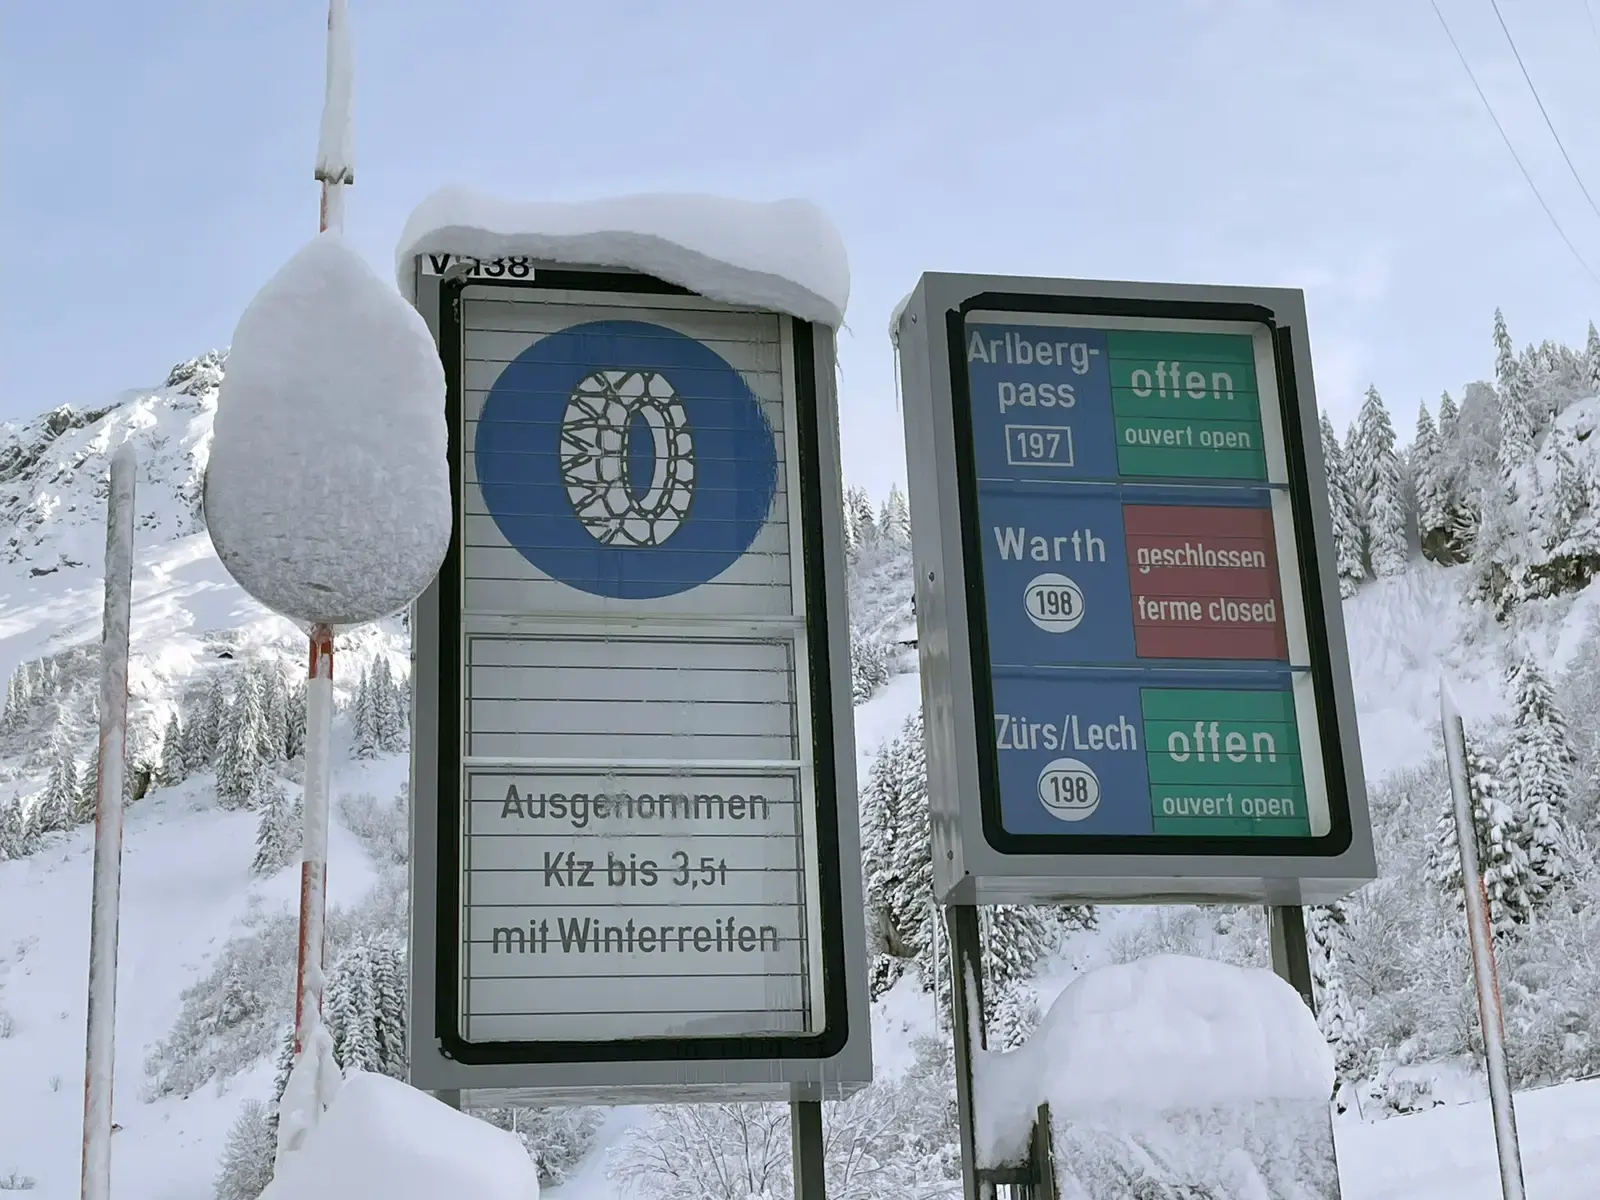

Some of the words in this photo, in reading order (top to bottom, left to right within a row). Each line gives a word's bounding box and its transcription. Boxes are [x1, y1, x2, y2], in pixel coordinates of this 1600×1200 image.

[967, 331, 1100, 375] Arlberg-
[998, 381, 1075, 414] pass
[1131, 361, 1235, 400] offen
[1016, 431, 1060, 459] 197
[1125, 426, 1193, 446] ouvert
[1199, 429, 1251, 452] open
[993, 526, 1106, 563] Warth
[1136, 543, 1266, 574] geschlossen
[1035, 590, 1073, 616] 198
[1208, 597, 1277, 623] closed
[994, 714, 1137, 751] Zürs/Lech
[1167, 721, 1277, 763] offen
[500, 784, 770, 828] Ausgenommen
[1050, 776, 1088, 803] 198
[1162, 793, 1233, 816] ouvert
[1240, 797, 1295, 821] open
[543, 851, 595, 887] Kfz
[607, 851, 658, 886] bis
[671, 850, 727, 890] 3,5t
[492, 918, 549, 954] mit
[557, 917, 781, 953] Winterreifen
